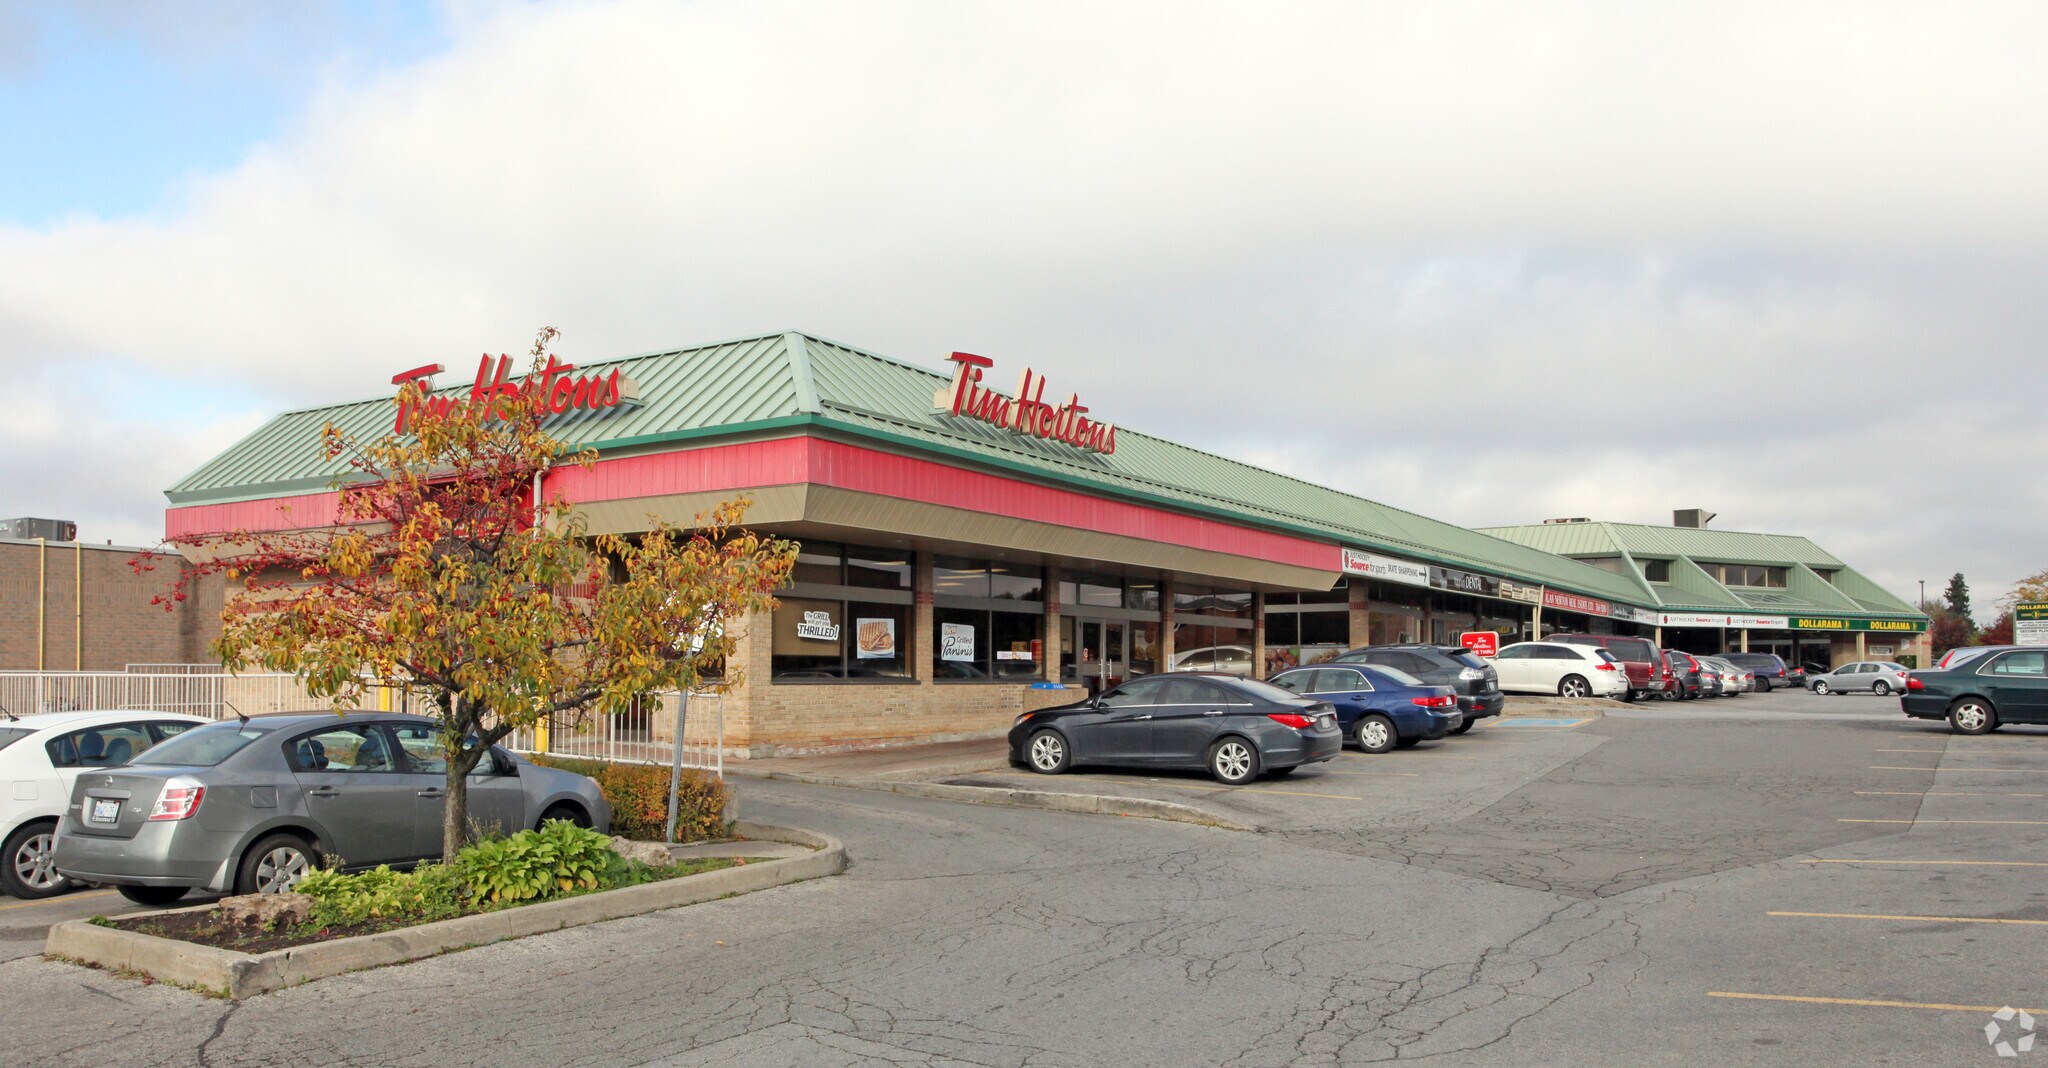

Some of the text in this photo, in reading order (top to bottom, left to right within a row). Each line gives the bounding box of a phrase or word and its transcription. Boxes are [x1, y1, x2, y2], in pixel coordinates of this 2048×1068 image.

[951, 351, 1116, 455] Tim Hortons
[1350, 551, 1370, 561] JUST HOCKEY
[1350, 559, 1369, 571] Source
[1375, 564, 1387, 575] sports
[1388, 563, 1418, 577] SKATE SHARPENING
[1466, 576, 1482, 590] DENTAL
[813, 612, 828, 620] GRILL
[1798, 619, 1842, 628] DOLLARAMA
[1870, 621, 1910, 630] DOLLARAMA
[799, 624, 838, 638] THRILLED!
[942, 636, 973, 657] Paninis
[956, 636, 972, 644] Grilled
